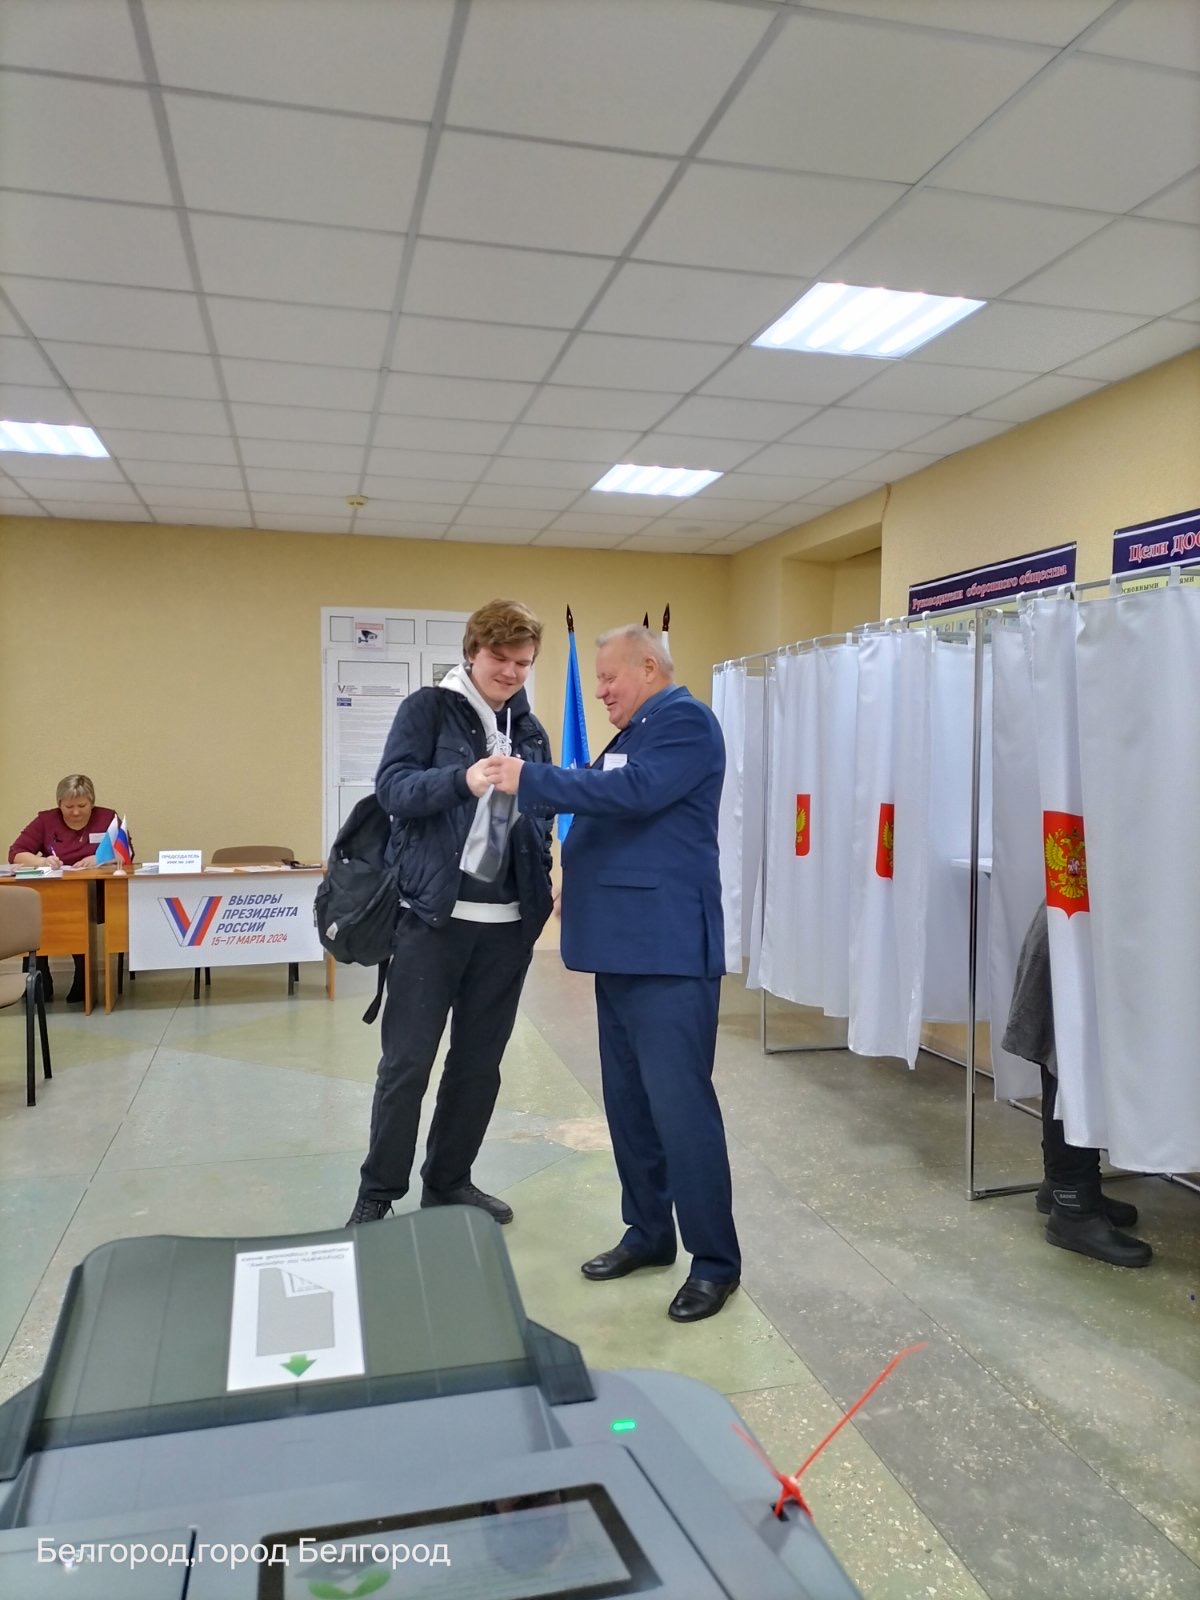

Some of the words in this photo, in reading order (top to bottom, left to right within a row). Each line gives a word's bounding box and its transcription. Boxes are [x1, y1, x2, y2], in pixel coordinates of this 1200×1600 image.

[1128, 541, 1169, 563] Цели
[1019, 564, 1067, 586] общества
[228, 894, 282, 906] ВЫБОРЫ
[222, 906, 298, 920] ПРЕЗИДЕНТА
[215, 921, 266, 934] РОССИИ
[236, 934, 266, 945] МАРТА
[267, 933, 288, 944] 2024
